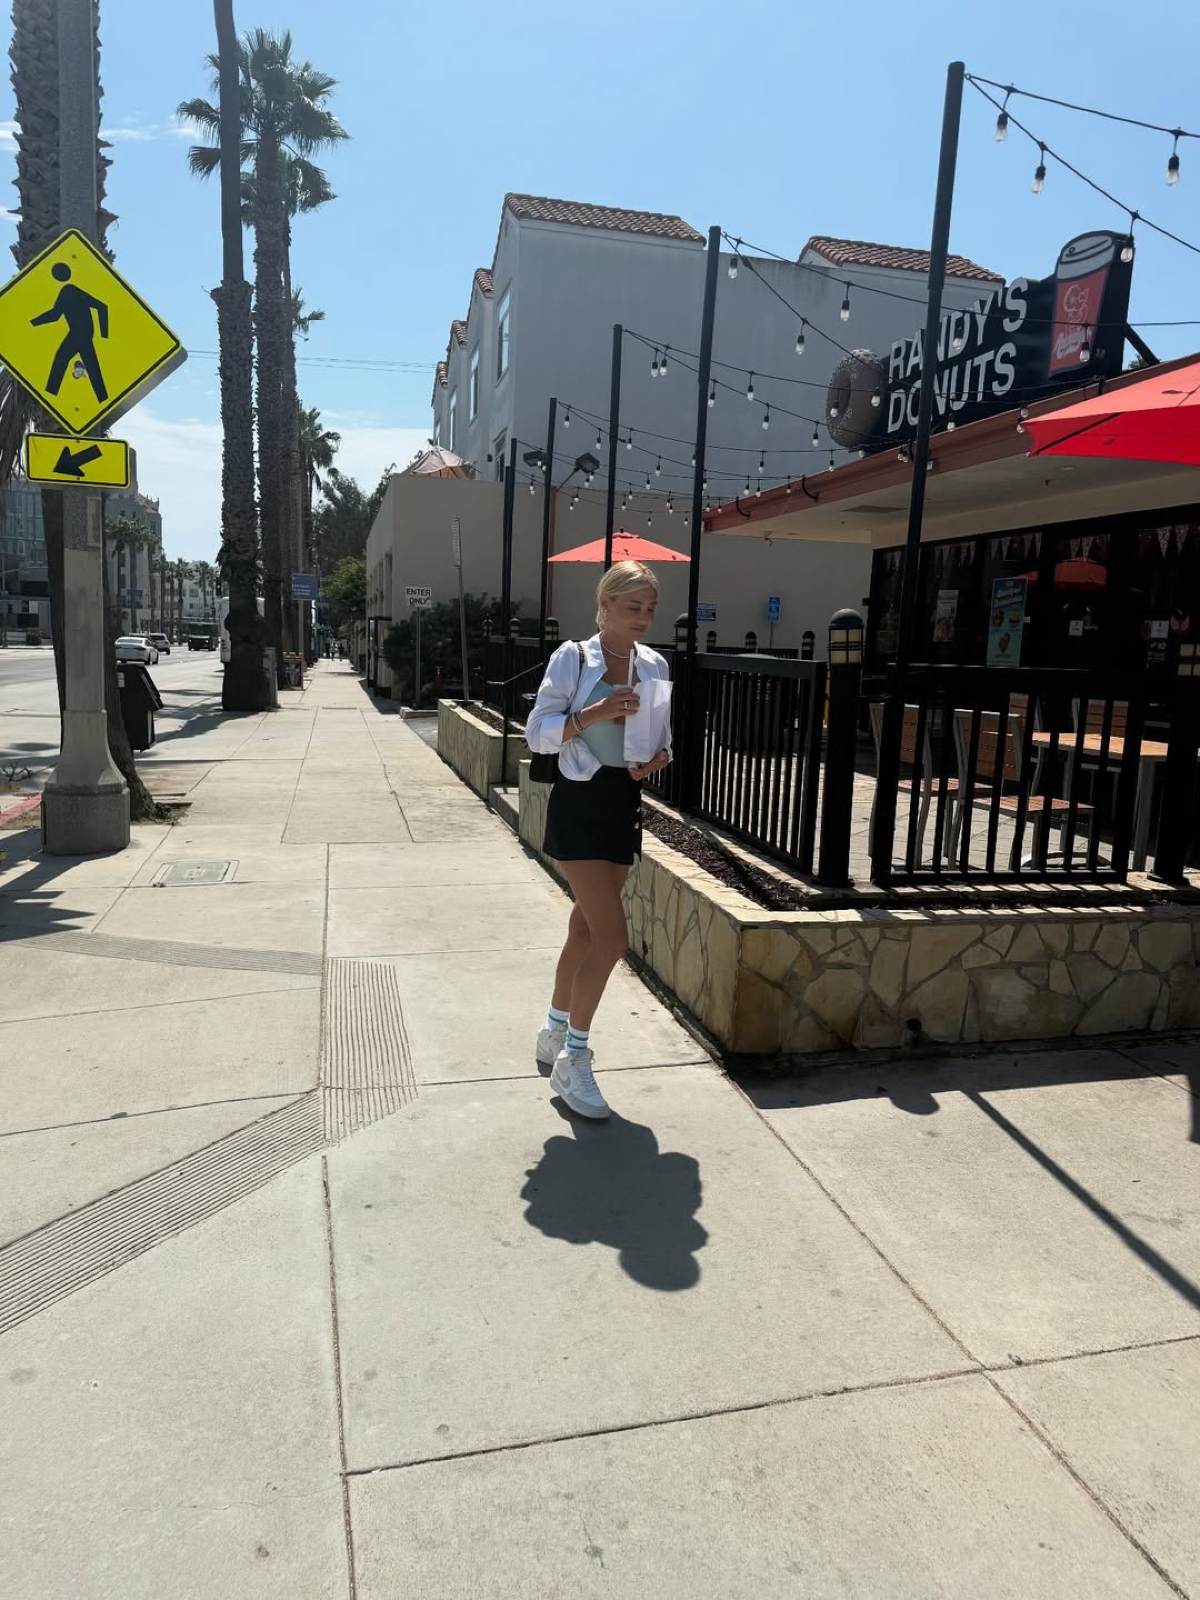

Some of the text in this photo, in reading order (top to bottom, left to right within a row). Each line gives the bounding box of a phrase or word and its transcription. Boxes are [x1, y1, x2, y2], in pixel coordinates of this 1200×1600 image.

[888, 342, 1017, 434] DONUTS
[406, 588, 431, 597] ENTER
[409, 597, 430, 606] ONLY
